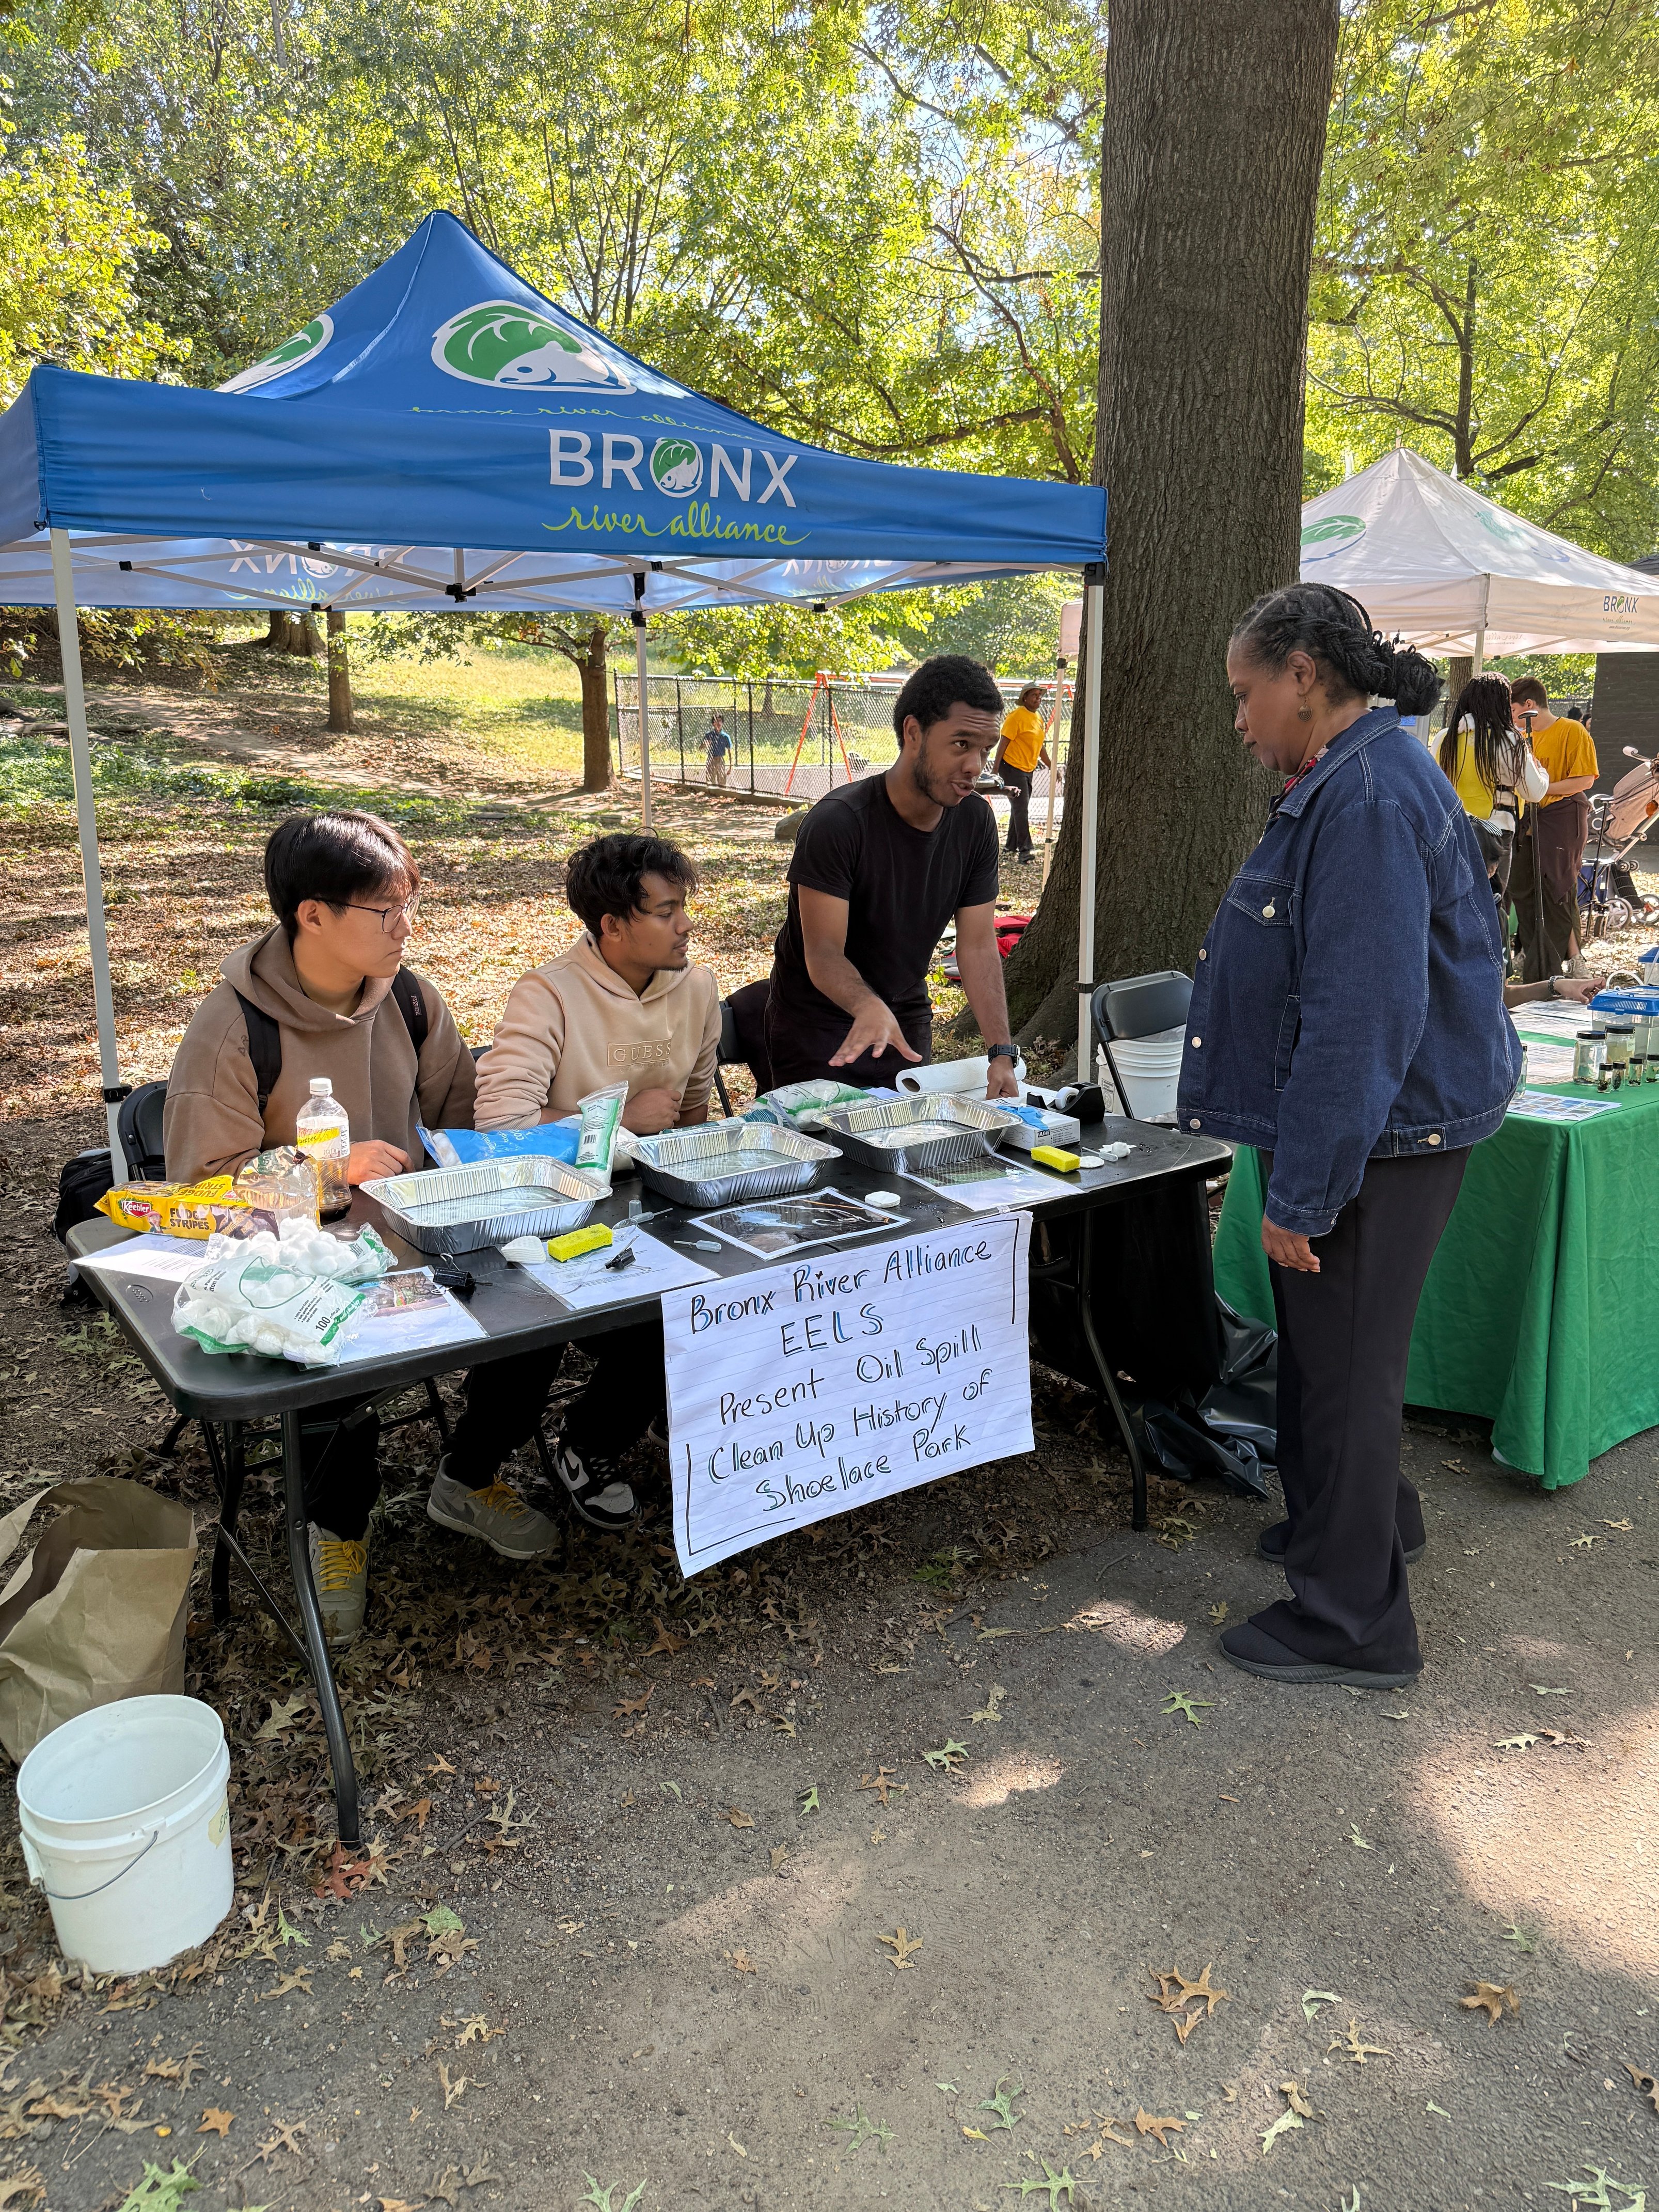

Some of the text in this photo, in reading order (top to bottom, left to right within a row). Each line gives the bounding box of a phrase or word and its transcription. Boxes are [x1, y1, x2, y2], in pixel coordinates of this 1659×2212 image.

[537, 406, 622, 416] river
[548, 429, 797, 508] BRONX
[542, 500, 811, 546] river alliance
[1603, 595, 1639, 613] BRONX
[613, 1042, 671, 1062] GUESS
[178, 1188, 219, 1197] FUDGE
[123, 1200, 150, 1214] Keebler
[170, 1208, 207, 1220] FUDGE
[170, 1219, 210, 1230] STRIPES
[690, 1240, 991, 1334] Bronx River Alliance
[315, 1316, 330, 1331] 100
[780, 1303, 884, 1357] EELS
[720, 1324, 981, 1425] Present Oil Spill
[708, 1368, 993, 1484] Clean Up History of
[913, 1424, 971, 1462] Park
